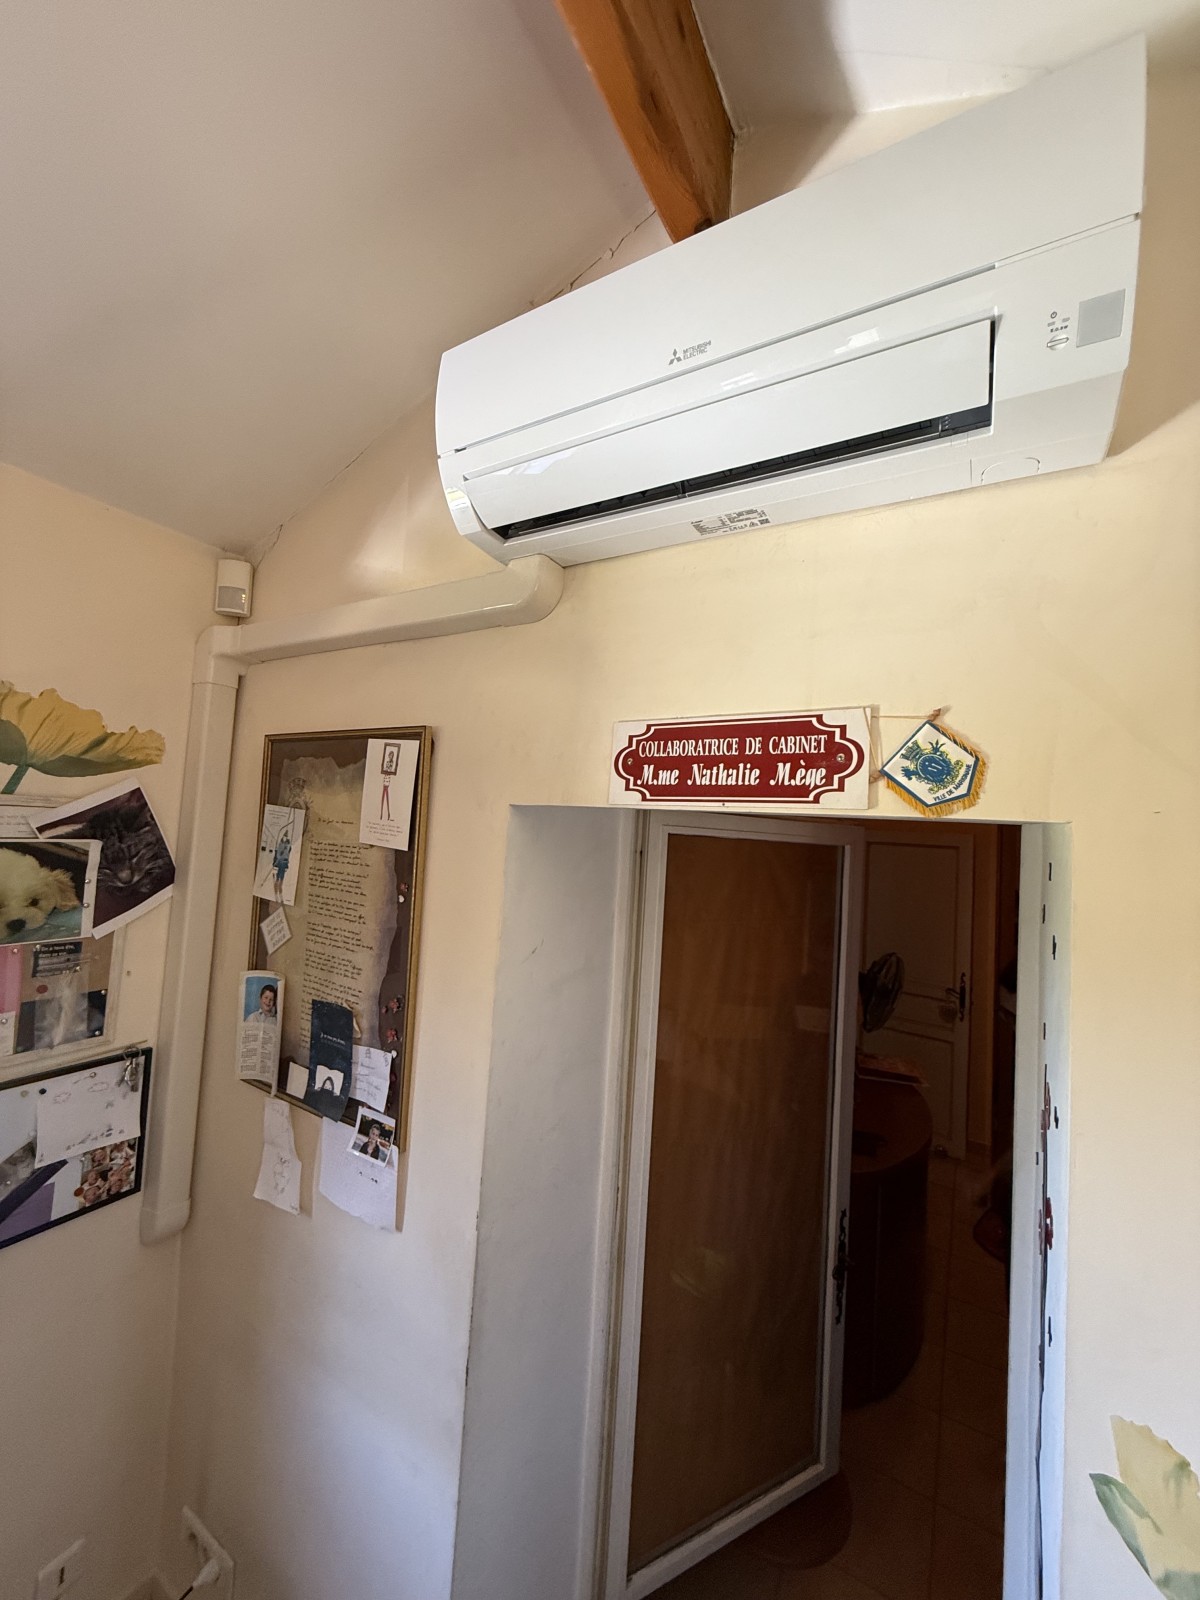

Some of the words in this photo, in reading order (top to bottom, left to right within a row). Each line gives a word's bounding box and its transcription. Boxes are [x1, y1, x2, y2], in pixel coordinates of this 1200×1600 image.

[682, 340, 712, 354] MITSUBISHI
[683, 346, 708, 360] ELECTRIC
[638, 738, 739, 757] COLLABORATRICE
[745, 737, 762, 755] DE
[769, 735, 827, 754] CABINET
[687, 763, 760, 785] Nathalie
[933, 793, 947, 801] VILLE
[946, 789, 955, 797] DE
